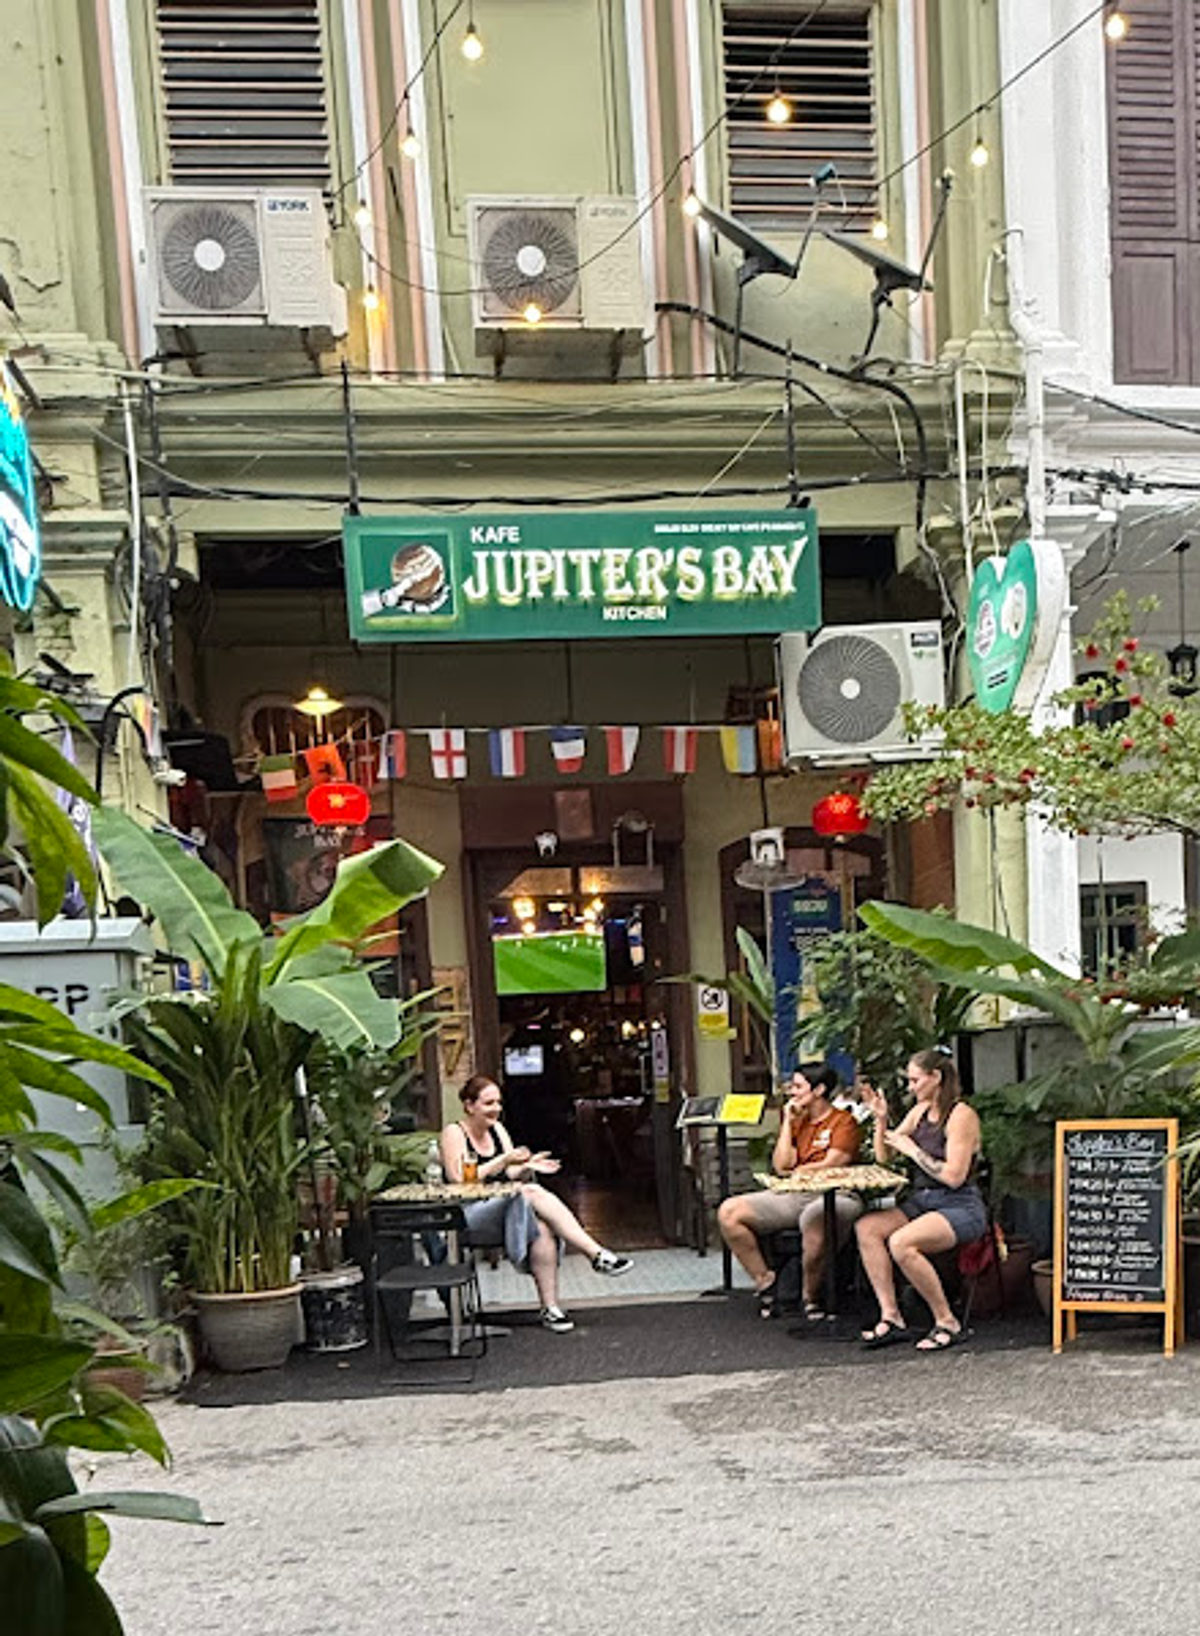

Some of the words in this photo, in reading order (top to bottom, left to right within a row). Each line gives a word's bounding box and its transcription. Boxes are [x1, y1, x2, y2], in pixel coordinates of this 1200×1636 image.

[470, 526, 521, 543] KAFE
[462, 546, 705, 600] JUPITER'S
[711, 535, 808, 596] BAY
[603, 606, 667, 620] KITCHEN
